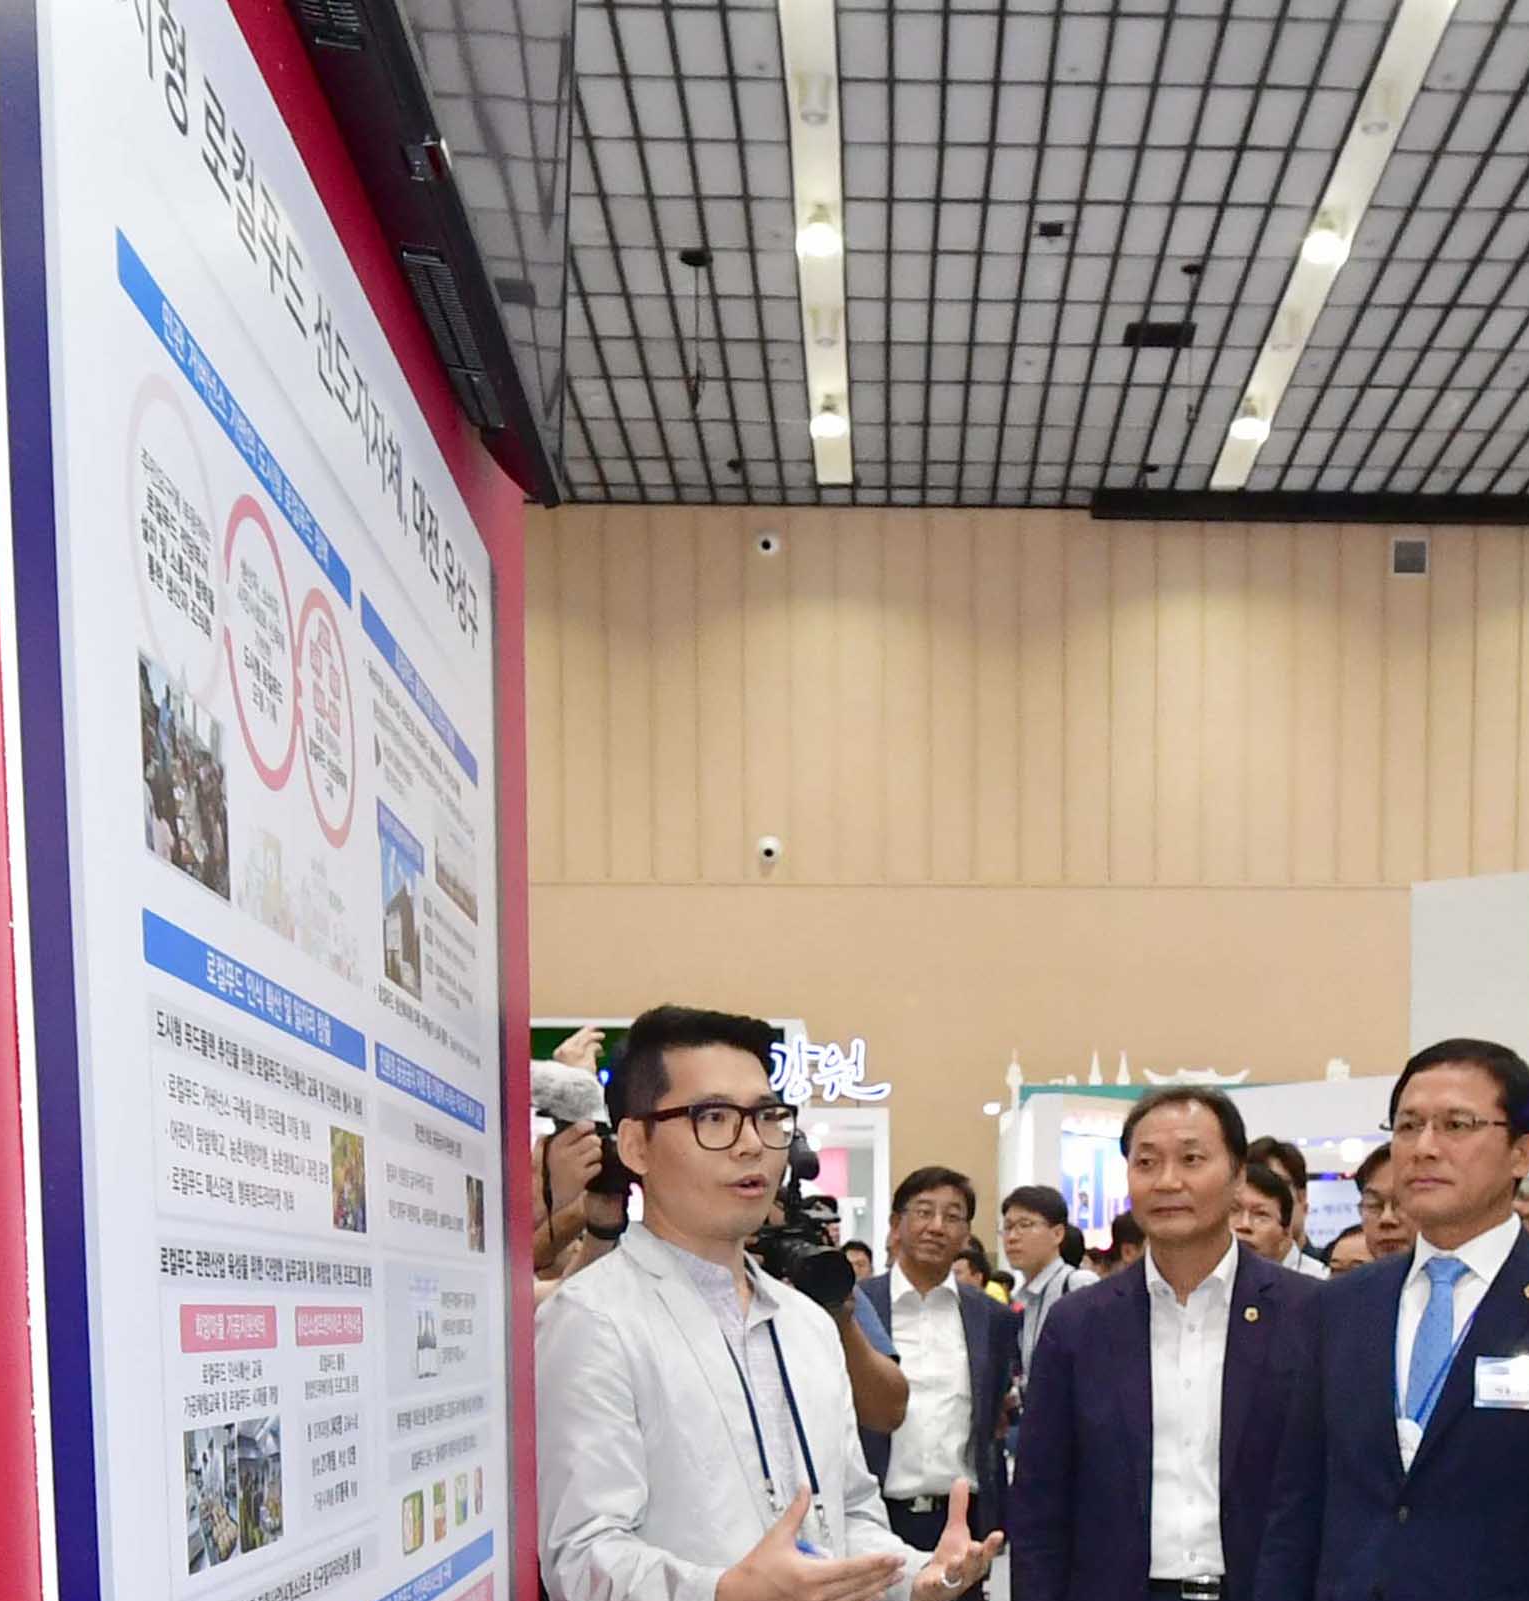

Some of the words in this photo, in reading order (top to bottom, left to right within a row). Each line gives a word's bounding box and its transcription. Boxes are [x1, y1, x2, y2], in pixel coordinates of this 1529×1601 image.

[200, 76, 307, 338] 로컬푸드
[314, 292, 408, 537] 선도지자체,
[412, 474, 439, 582] 대전
[445, 552, 480, 652] 유성구
[205, 947, 244, 1004] 로컬푸드
[245, 970, 262, 1012] 인식
[155, 1008, 182, 1051] 도시형
[770, 1037, 892, 1104] 강원
[159, 1246, 194, 1277] 로컬푸드
